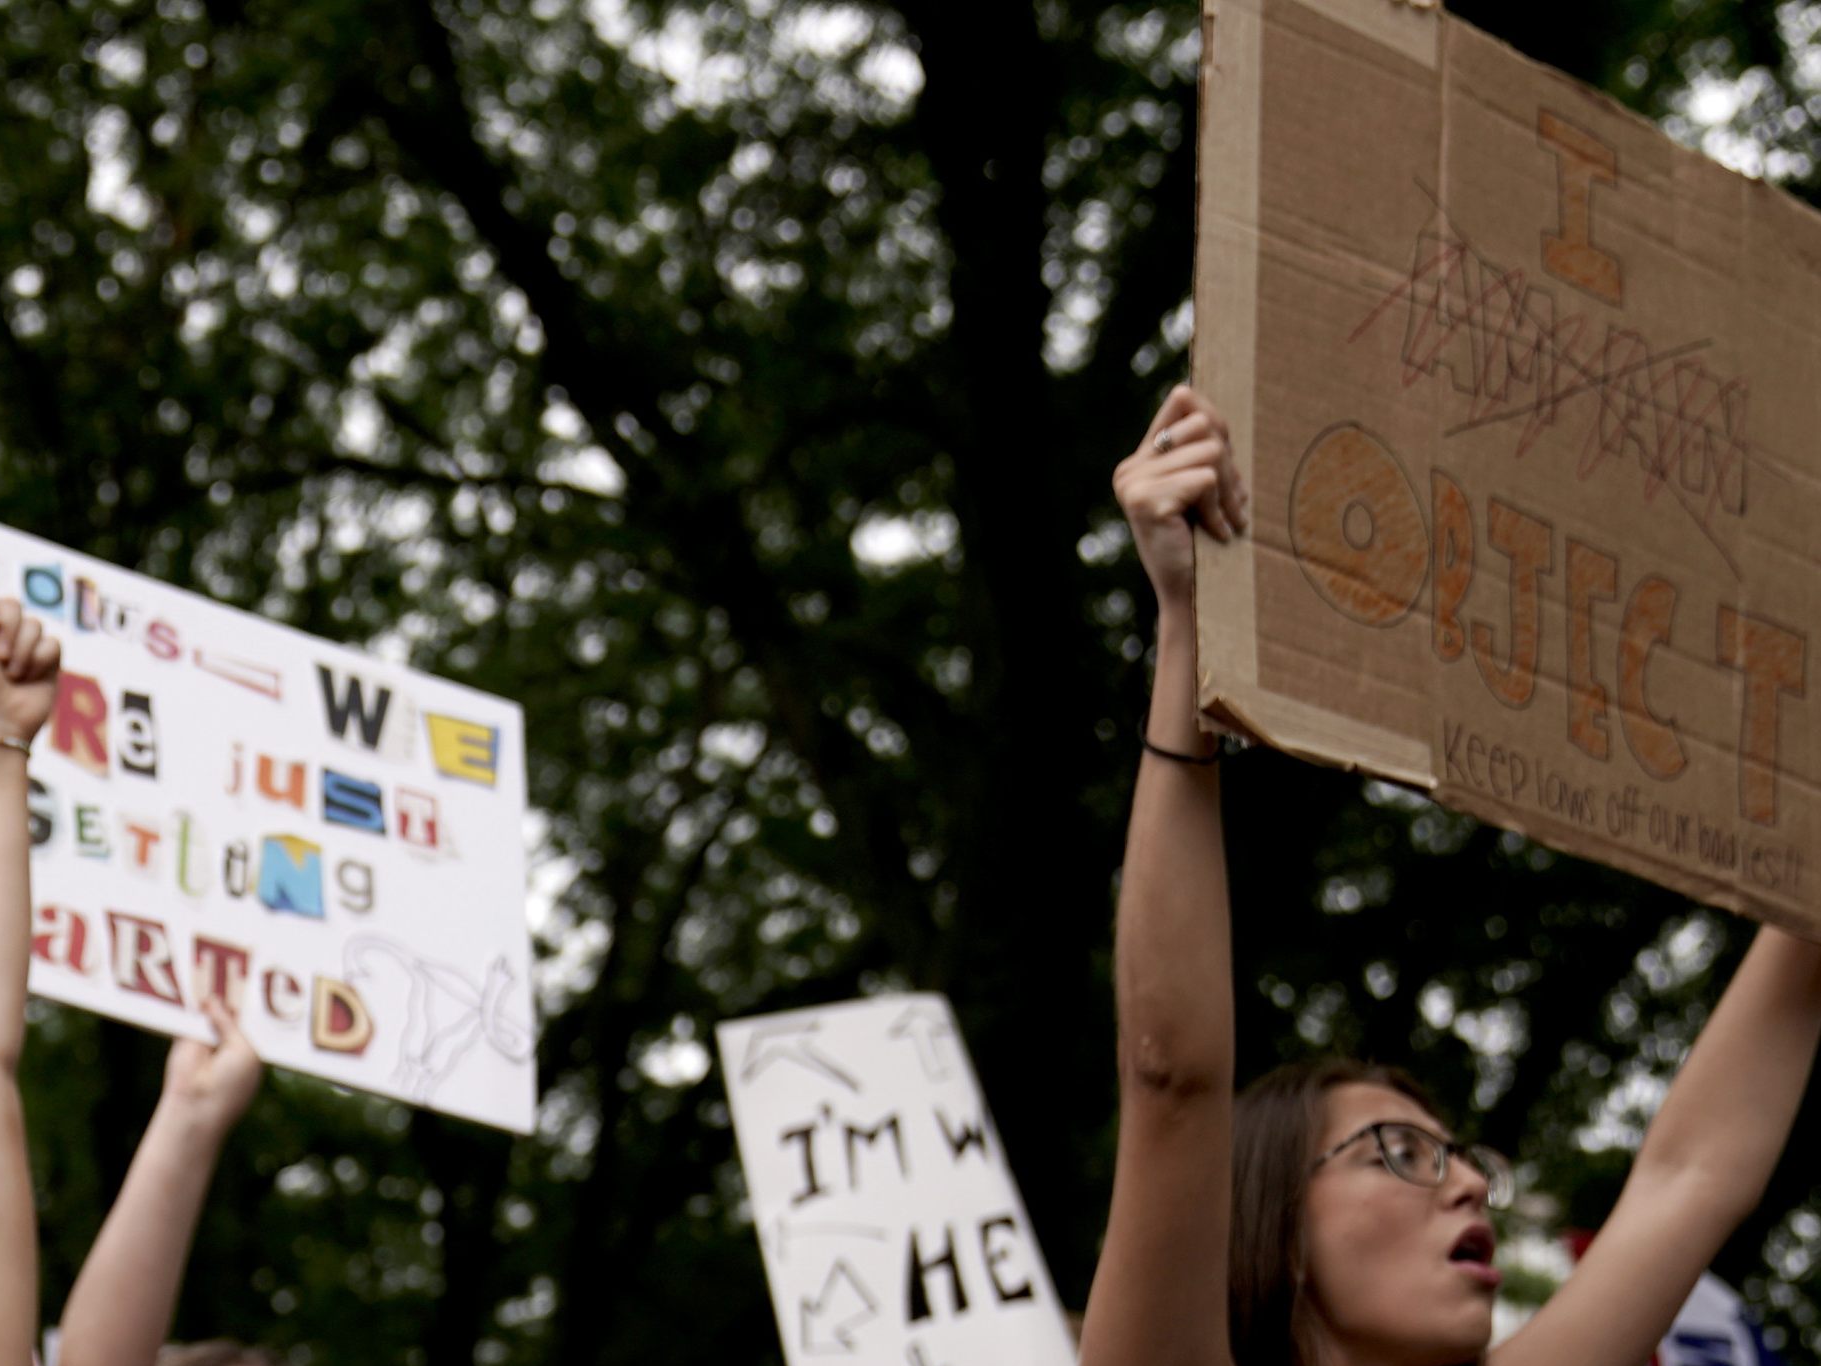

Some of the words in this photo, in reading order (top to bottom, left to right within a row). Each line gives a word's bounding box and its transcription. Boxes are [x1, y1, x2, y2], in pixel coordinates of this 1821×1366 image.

[1537, 104, 1625, 312] I
[1288, 420, 1808, 830] OBJECT
[780, 1102, 912, 1209] I'M
